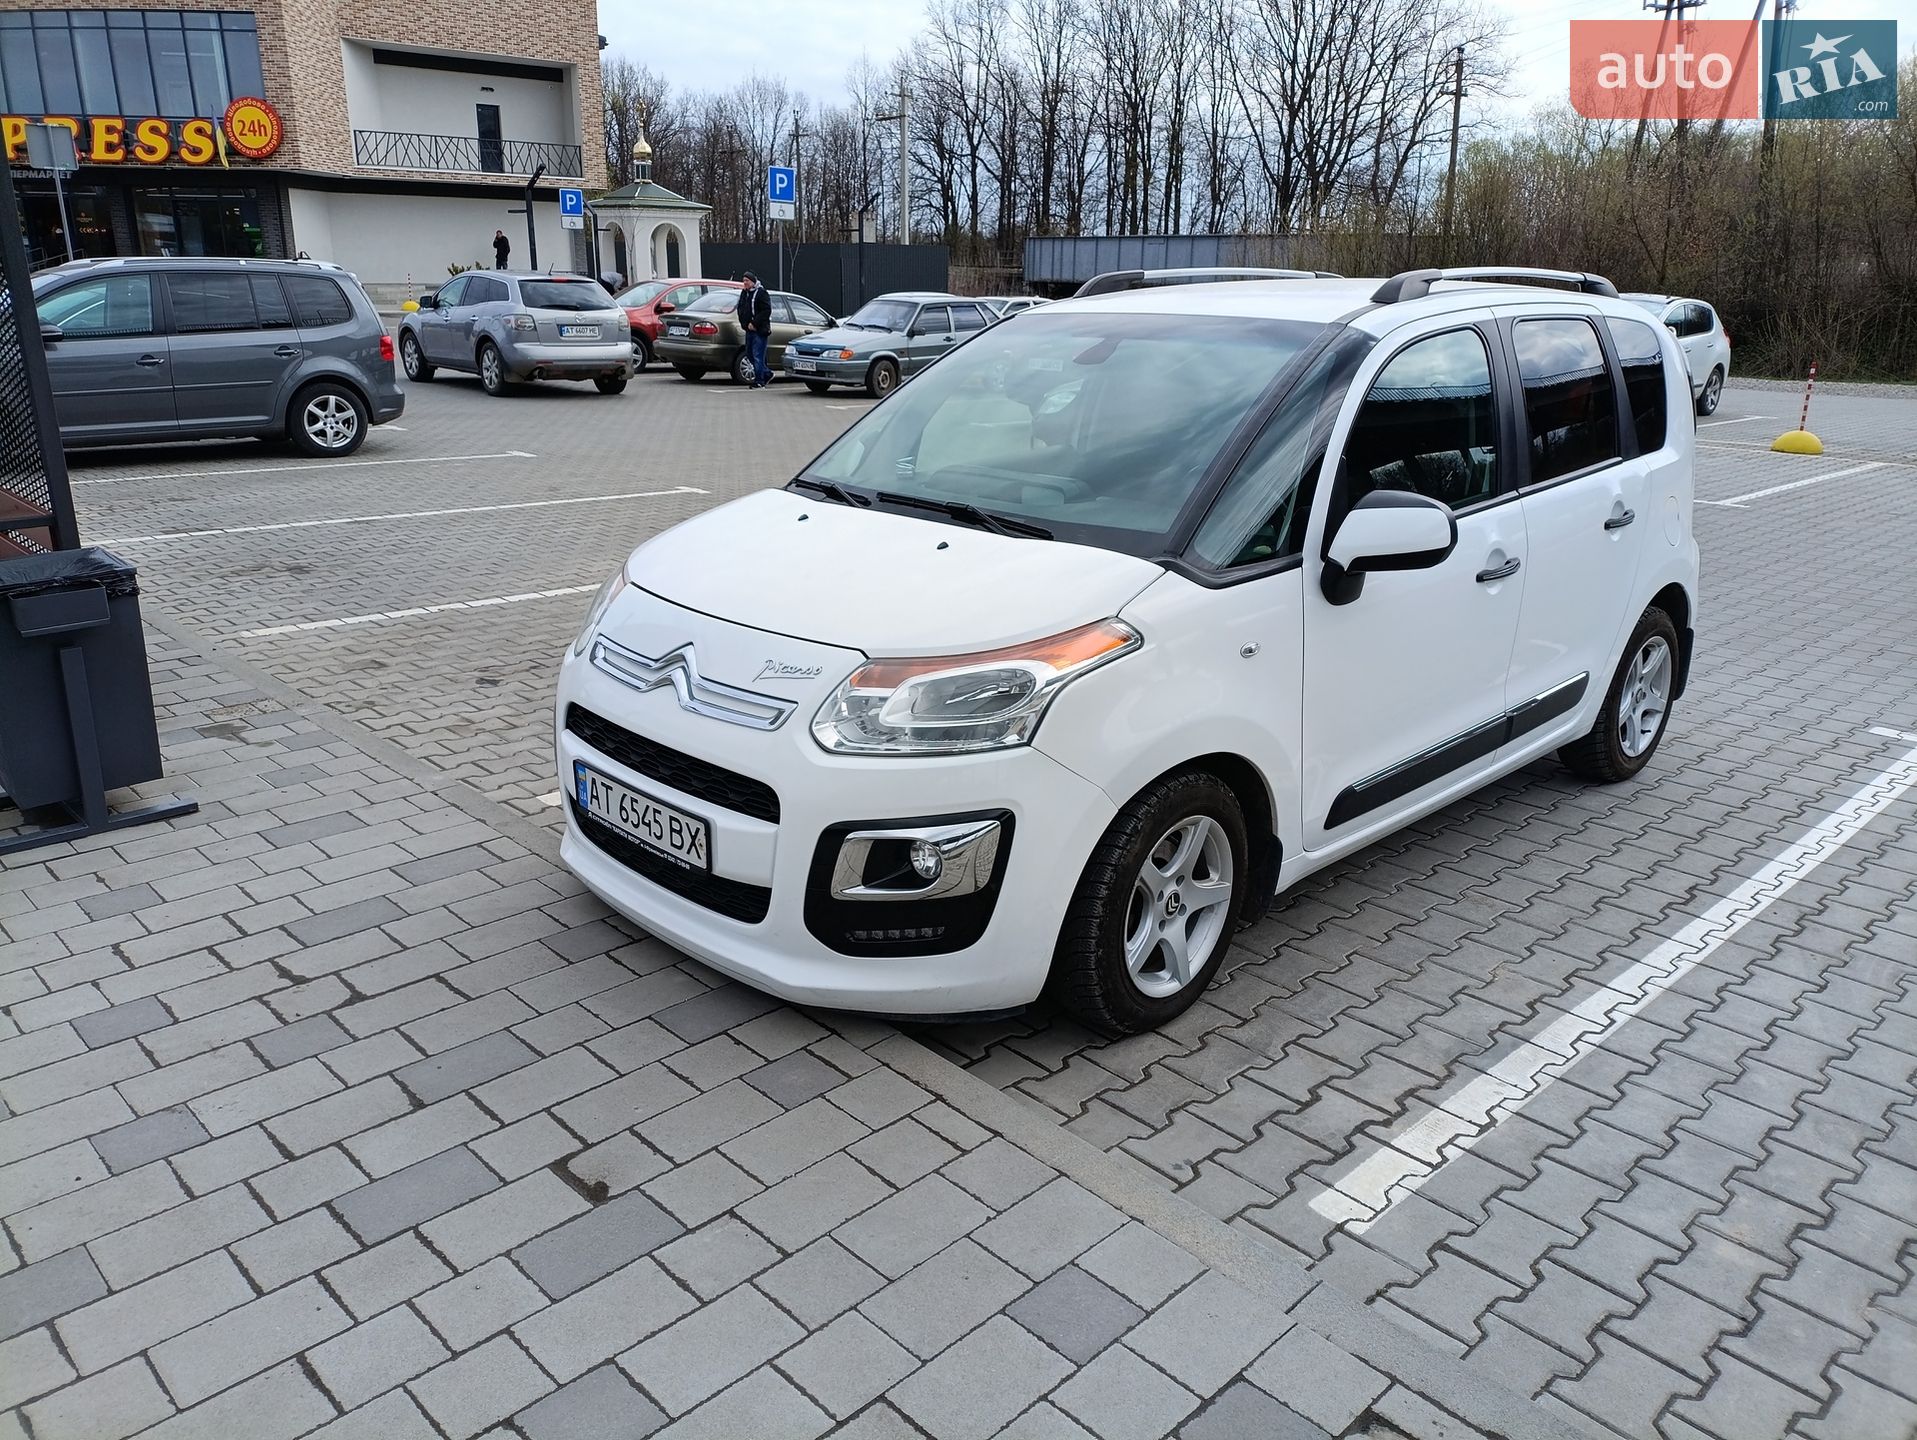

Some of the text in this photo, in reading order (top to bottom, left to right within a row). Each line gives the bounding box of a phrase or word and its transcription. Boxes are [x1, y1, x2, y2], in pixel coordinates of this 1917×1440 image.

[237, 118, 268, 137] 24h
[0, 116, 216, 164] PESS
[775, 173, 788, 195] P
[566, 194, 577, 211] P
[752, 659, 823, 682] Picasso
[590, 777, 702, 860] AT 6545 BX
